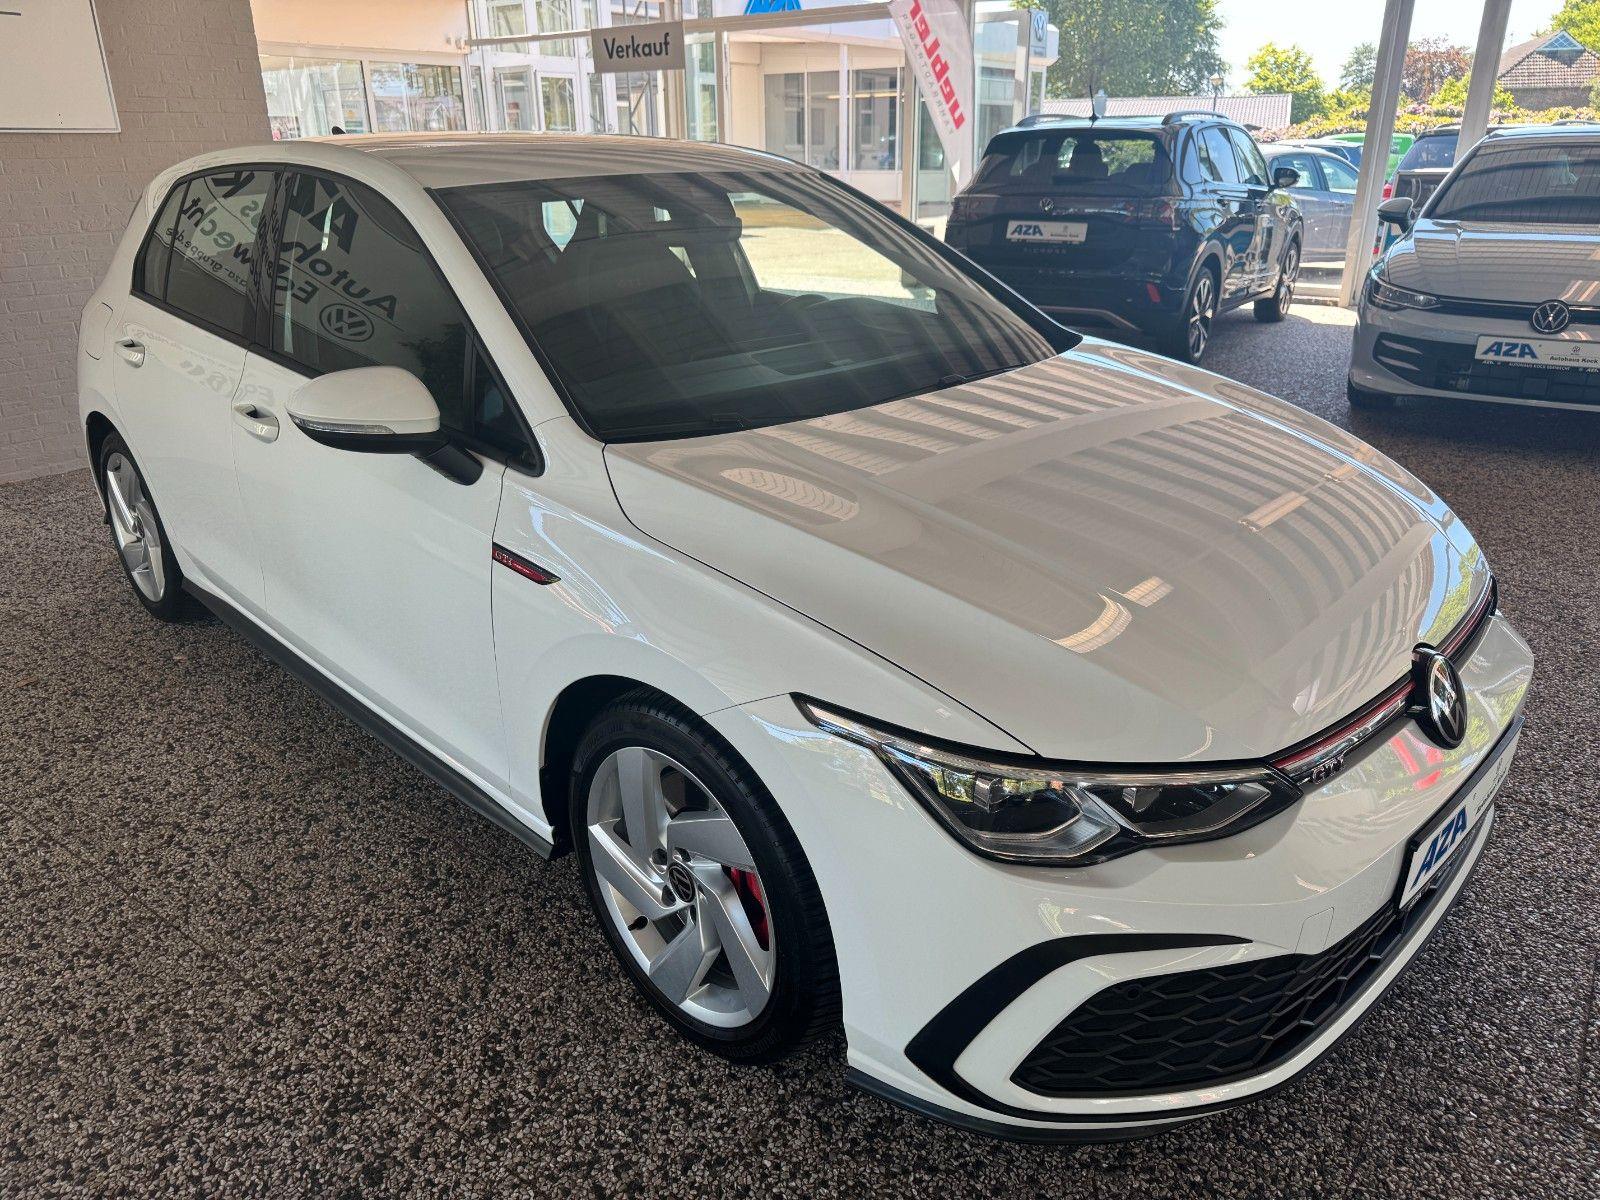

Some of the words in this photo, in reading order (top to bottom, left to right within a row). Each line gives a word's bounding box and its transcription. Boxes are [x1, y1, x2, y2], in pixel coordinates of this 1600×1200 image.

[603, 32, 671, 60] Verkauf
[1011, 224, 1044, 237] AZA
[1481, 341, 1538, 359] AZA
[1549, 355, 1580, 364] Autohaus
[1410, 806, 1468, 891] AZA
